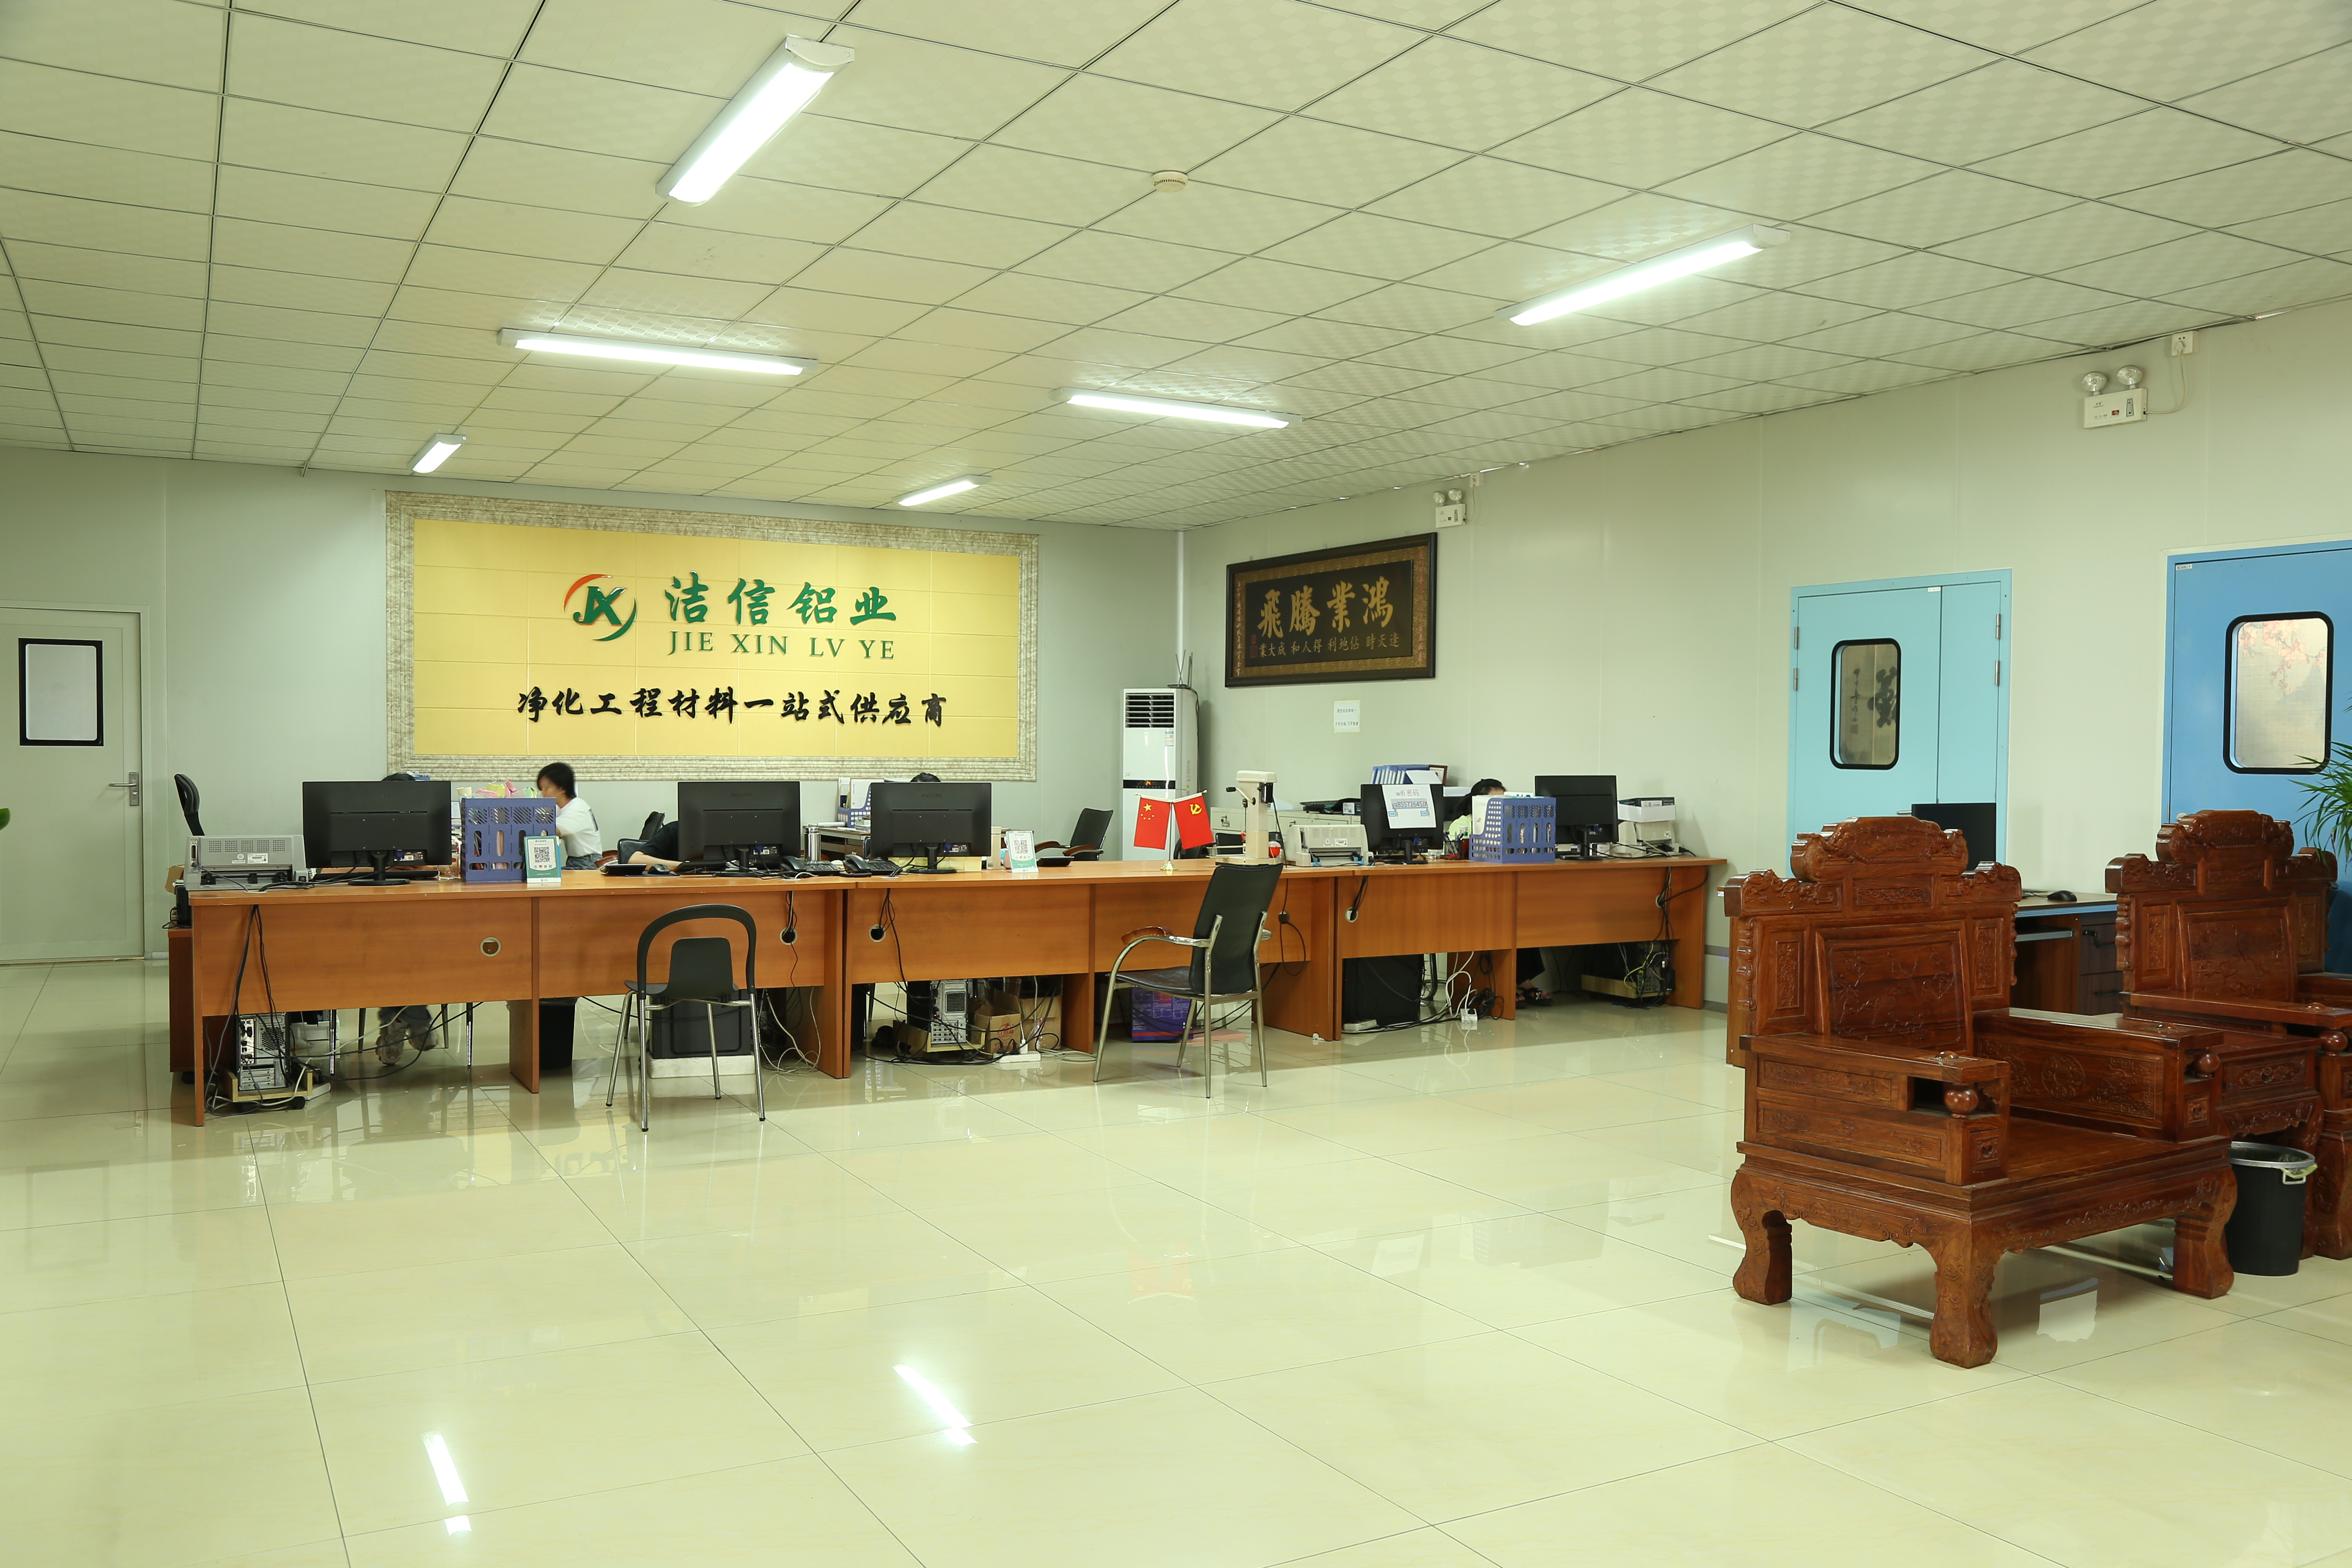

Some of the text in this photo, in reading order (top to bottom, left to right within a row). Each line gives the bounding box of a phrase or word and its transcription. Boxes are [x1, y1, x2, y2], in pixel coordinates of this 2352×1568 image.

[665, 571, 897, 625] 洁信铝业
[668, 631, 895, 660] JIE XIN LV YE
[518, 686, 947, 727] 净化工程材料一站式供应商
